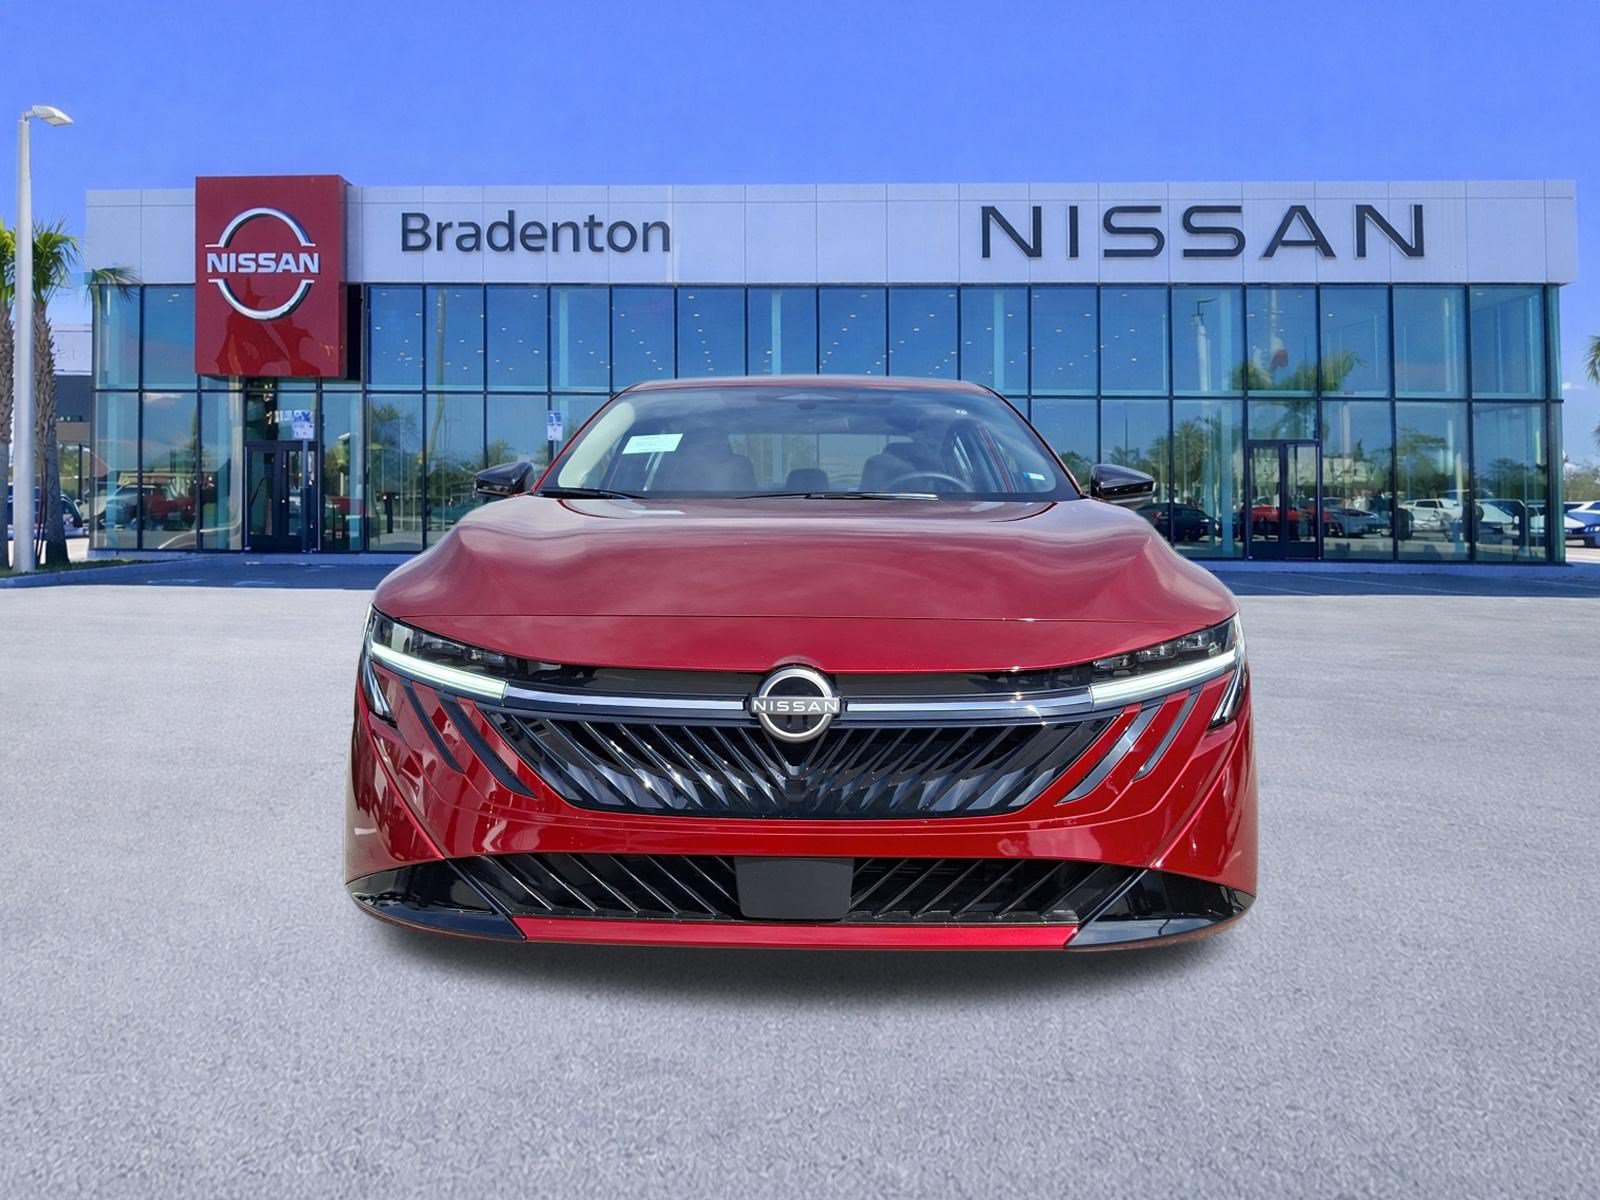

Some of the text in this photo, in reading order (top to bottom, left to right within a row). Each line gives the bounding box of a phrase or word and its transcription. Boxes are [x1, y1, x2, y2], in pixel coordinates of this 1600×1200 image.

[401, 210, 671, 253] Bradenton
[978, 205, 1425, 259] NISSAN
[206, 252, 320, 274] NISSAN
[753, 700, 837, 712] NISSAN
